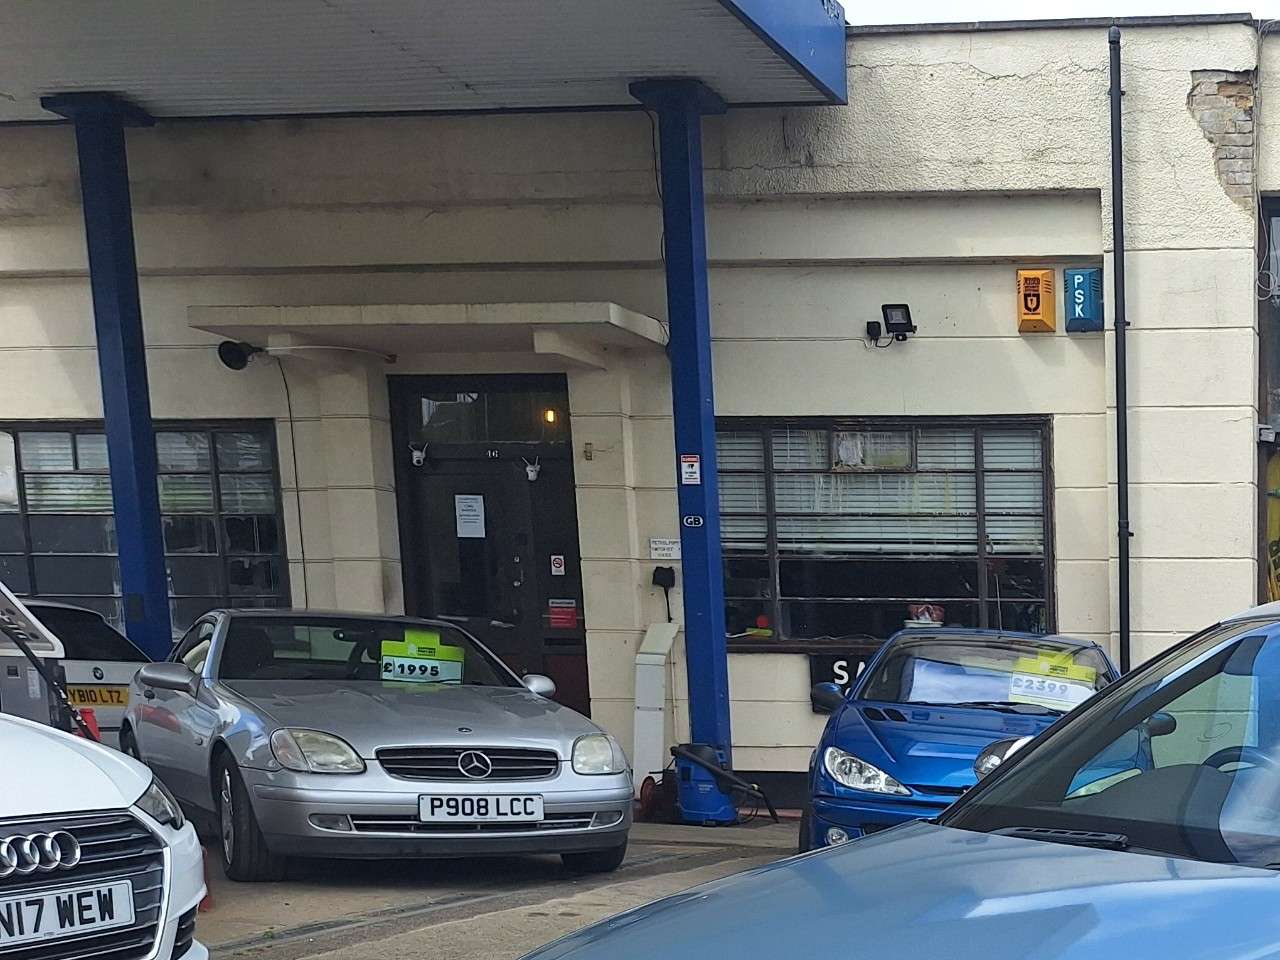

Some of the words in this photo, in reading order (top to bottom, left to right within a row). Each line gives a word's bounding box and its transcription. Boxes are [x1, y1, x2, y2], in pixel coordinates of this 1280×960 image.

[1073, 274, 1085, 318] PSK
[685, 516, 702, 526] GB
[383, 662, 440, 676] £1995
[1012, 676, 1068, 695] £2399
[99, 687, 124, 704] LTZ
[430, 797, 488, 816] P908
[496, 797, 535, 816] LCC
[56, 888, 114, 929] WEW
